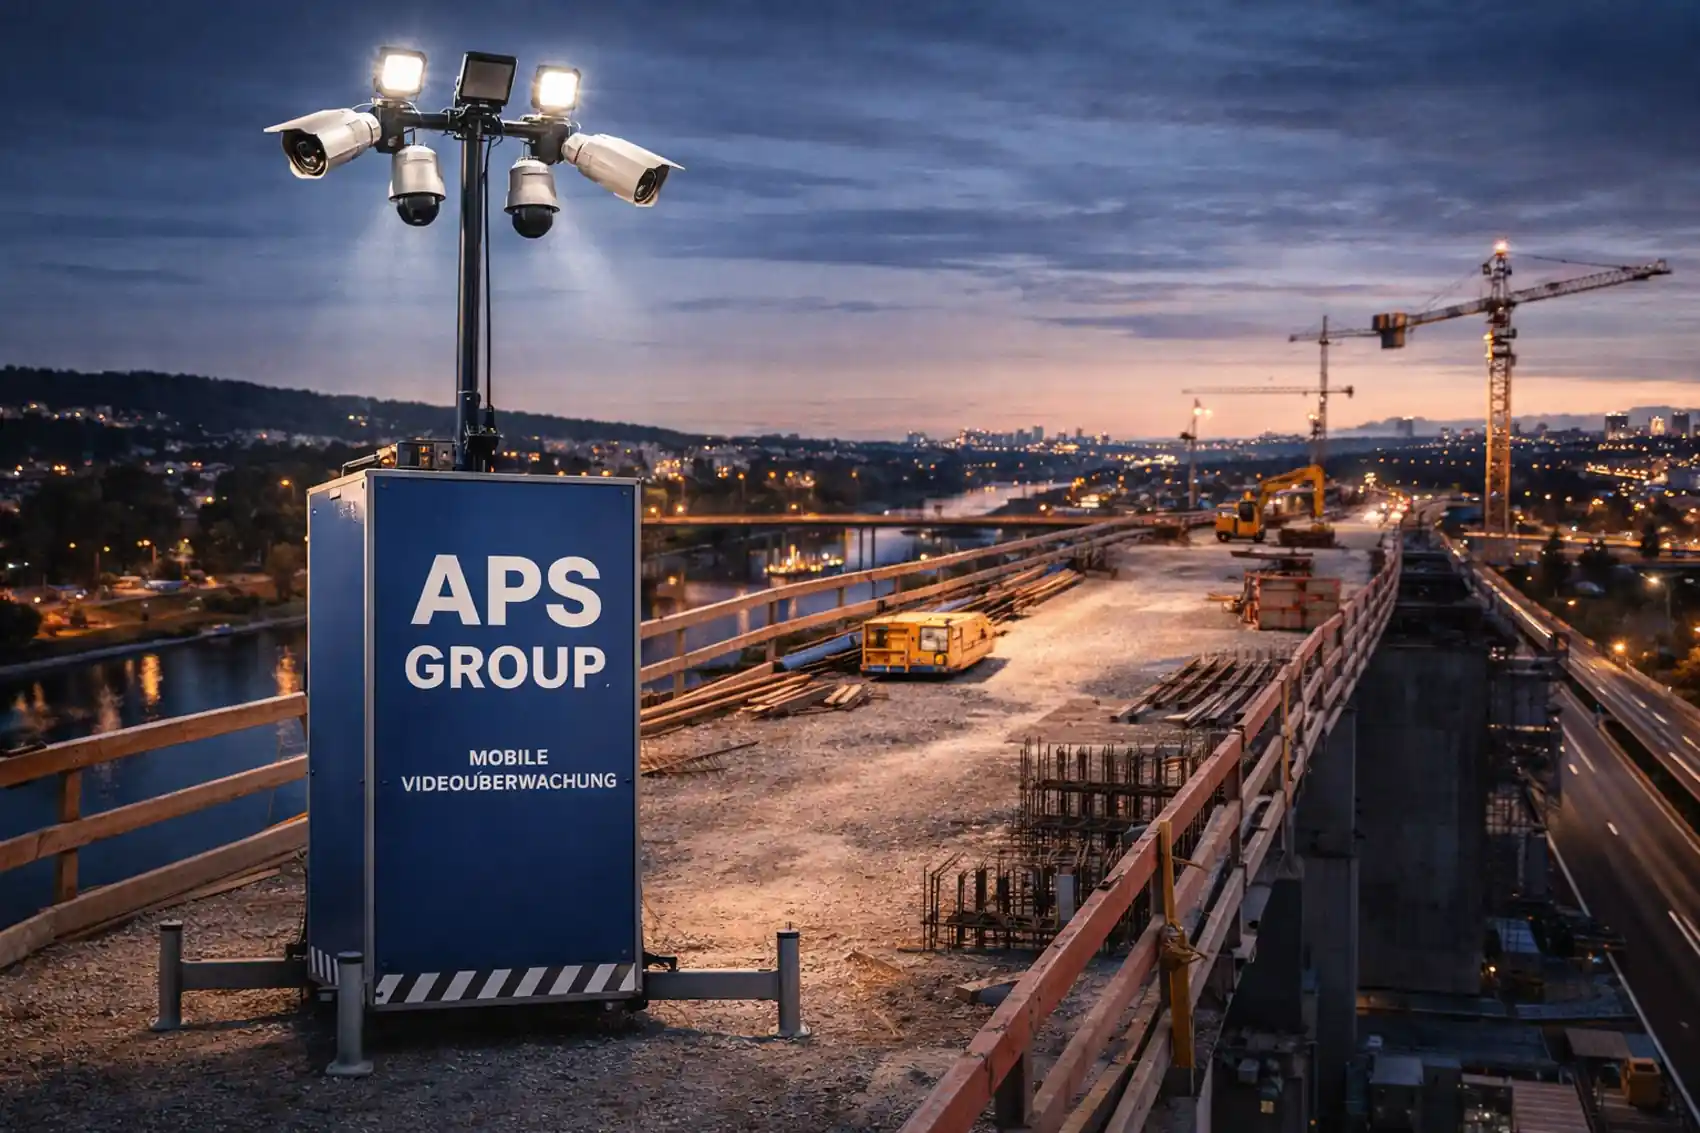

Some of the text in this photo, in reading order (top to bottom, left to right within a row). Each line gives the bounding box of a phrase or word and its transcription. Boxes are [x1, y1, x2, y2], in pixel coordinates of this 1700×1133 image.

[410, 554, 602, 628] APS
[405, 645, 606, 689] GROUP
[469, 749, 549, 766] MOBILE
